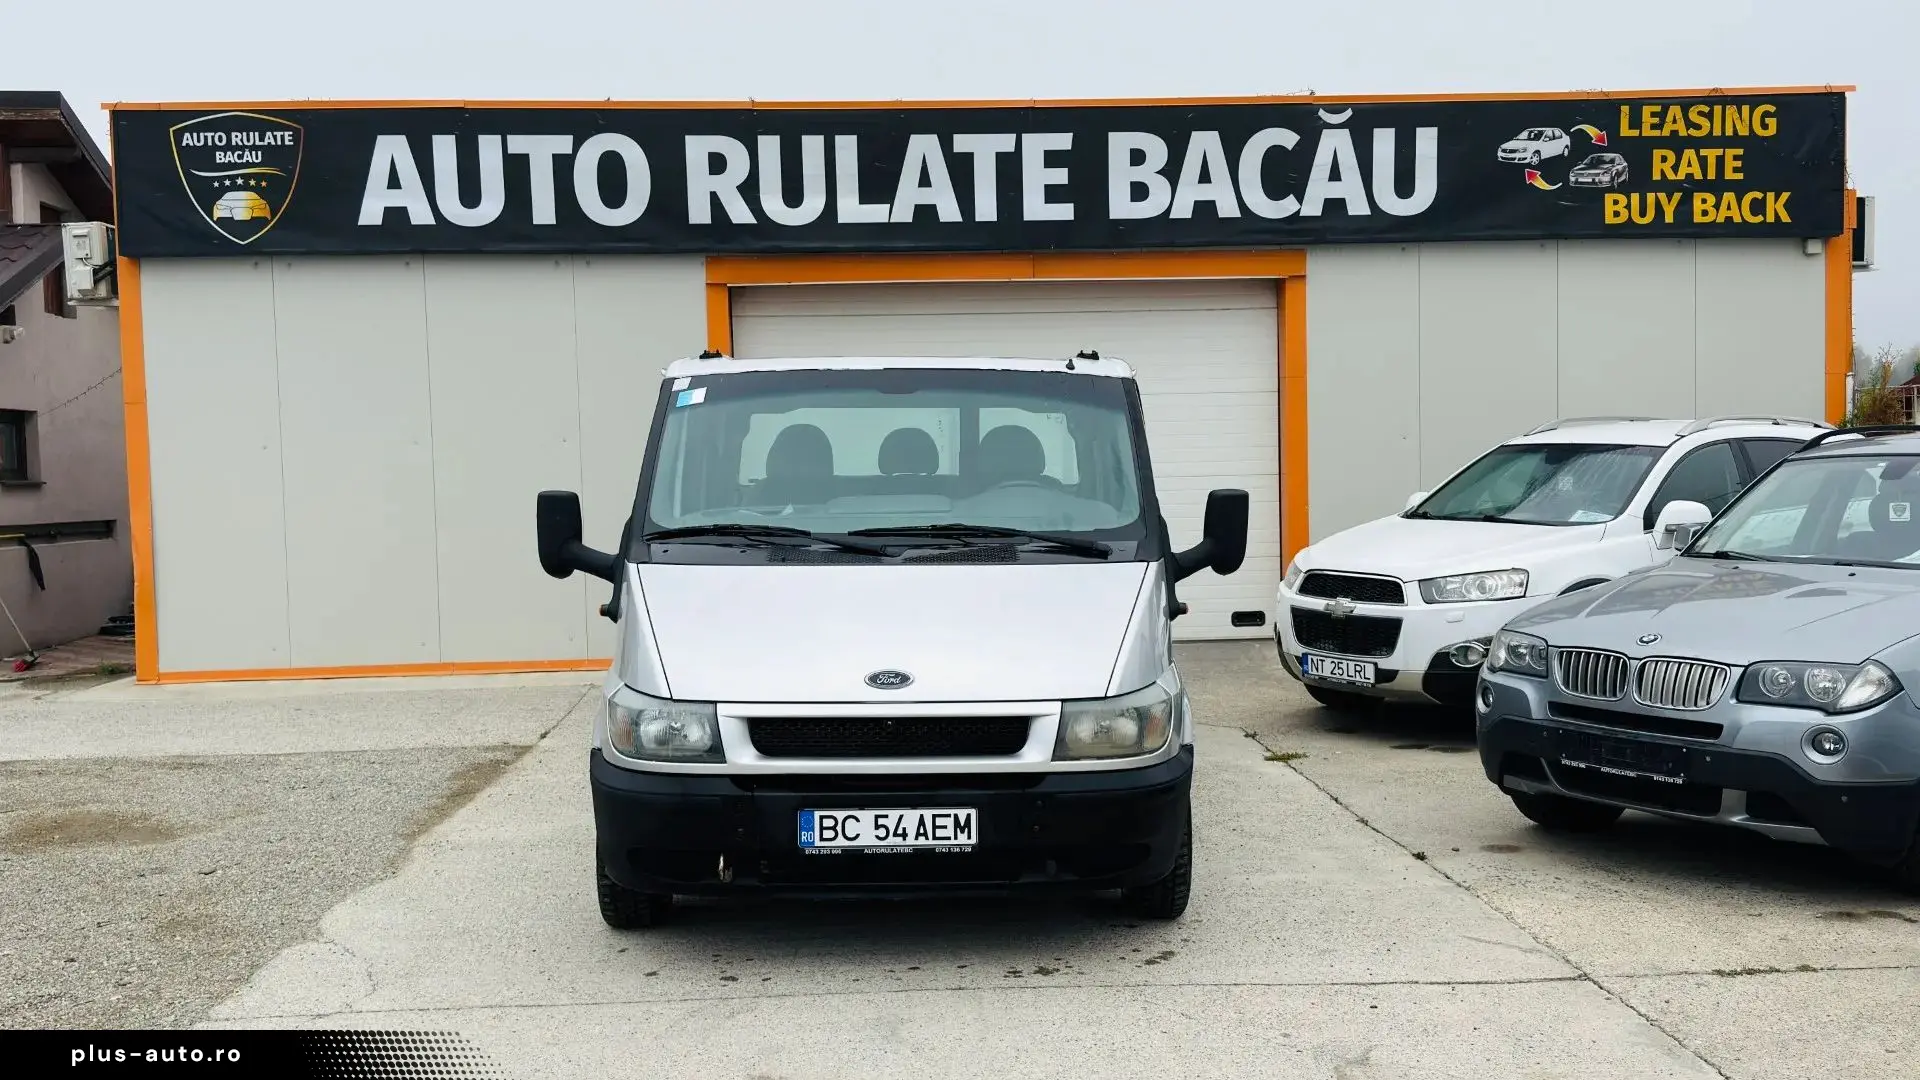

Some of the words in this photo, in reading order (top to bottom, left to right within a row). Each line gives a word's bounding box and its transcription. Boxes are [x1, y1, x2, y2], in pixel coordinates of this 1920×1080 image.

[1619, 104, 1777, 137] LEASING
[182, 132, 227, 146] AUTO
[231, 131, 293, 145] RULATE
[215, 149, 262, 163] BACĂU
[357, 132, 652, 228] AUTO
[685, 132, 1074, 226] RULATE
[1107, 107, 1439, 220] BACĂU
[1652, 148, 1745, 181] RATE
[1604, 192, 1682, 225] BUY
[1693, 191, 1792, 223] BACK
[876, 673, 902, 684] Ford
[1310, 657, 1325, 674] NT
[1330, 661, 1344, 676] 25
[1346, 662, 1371, 681] LRL
[801, 831, 814, 843] RO
[819, 814, 861, 842] BC
[874, 814, 909, 841] 54
[914, 812, 972, 841] AEM
